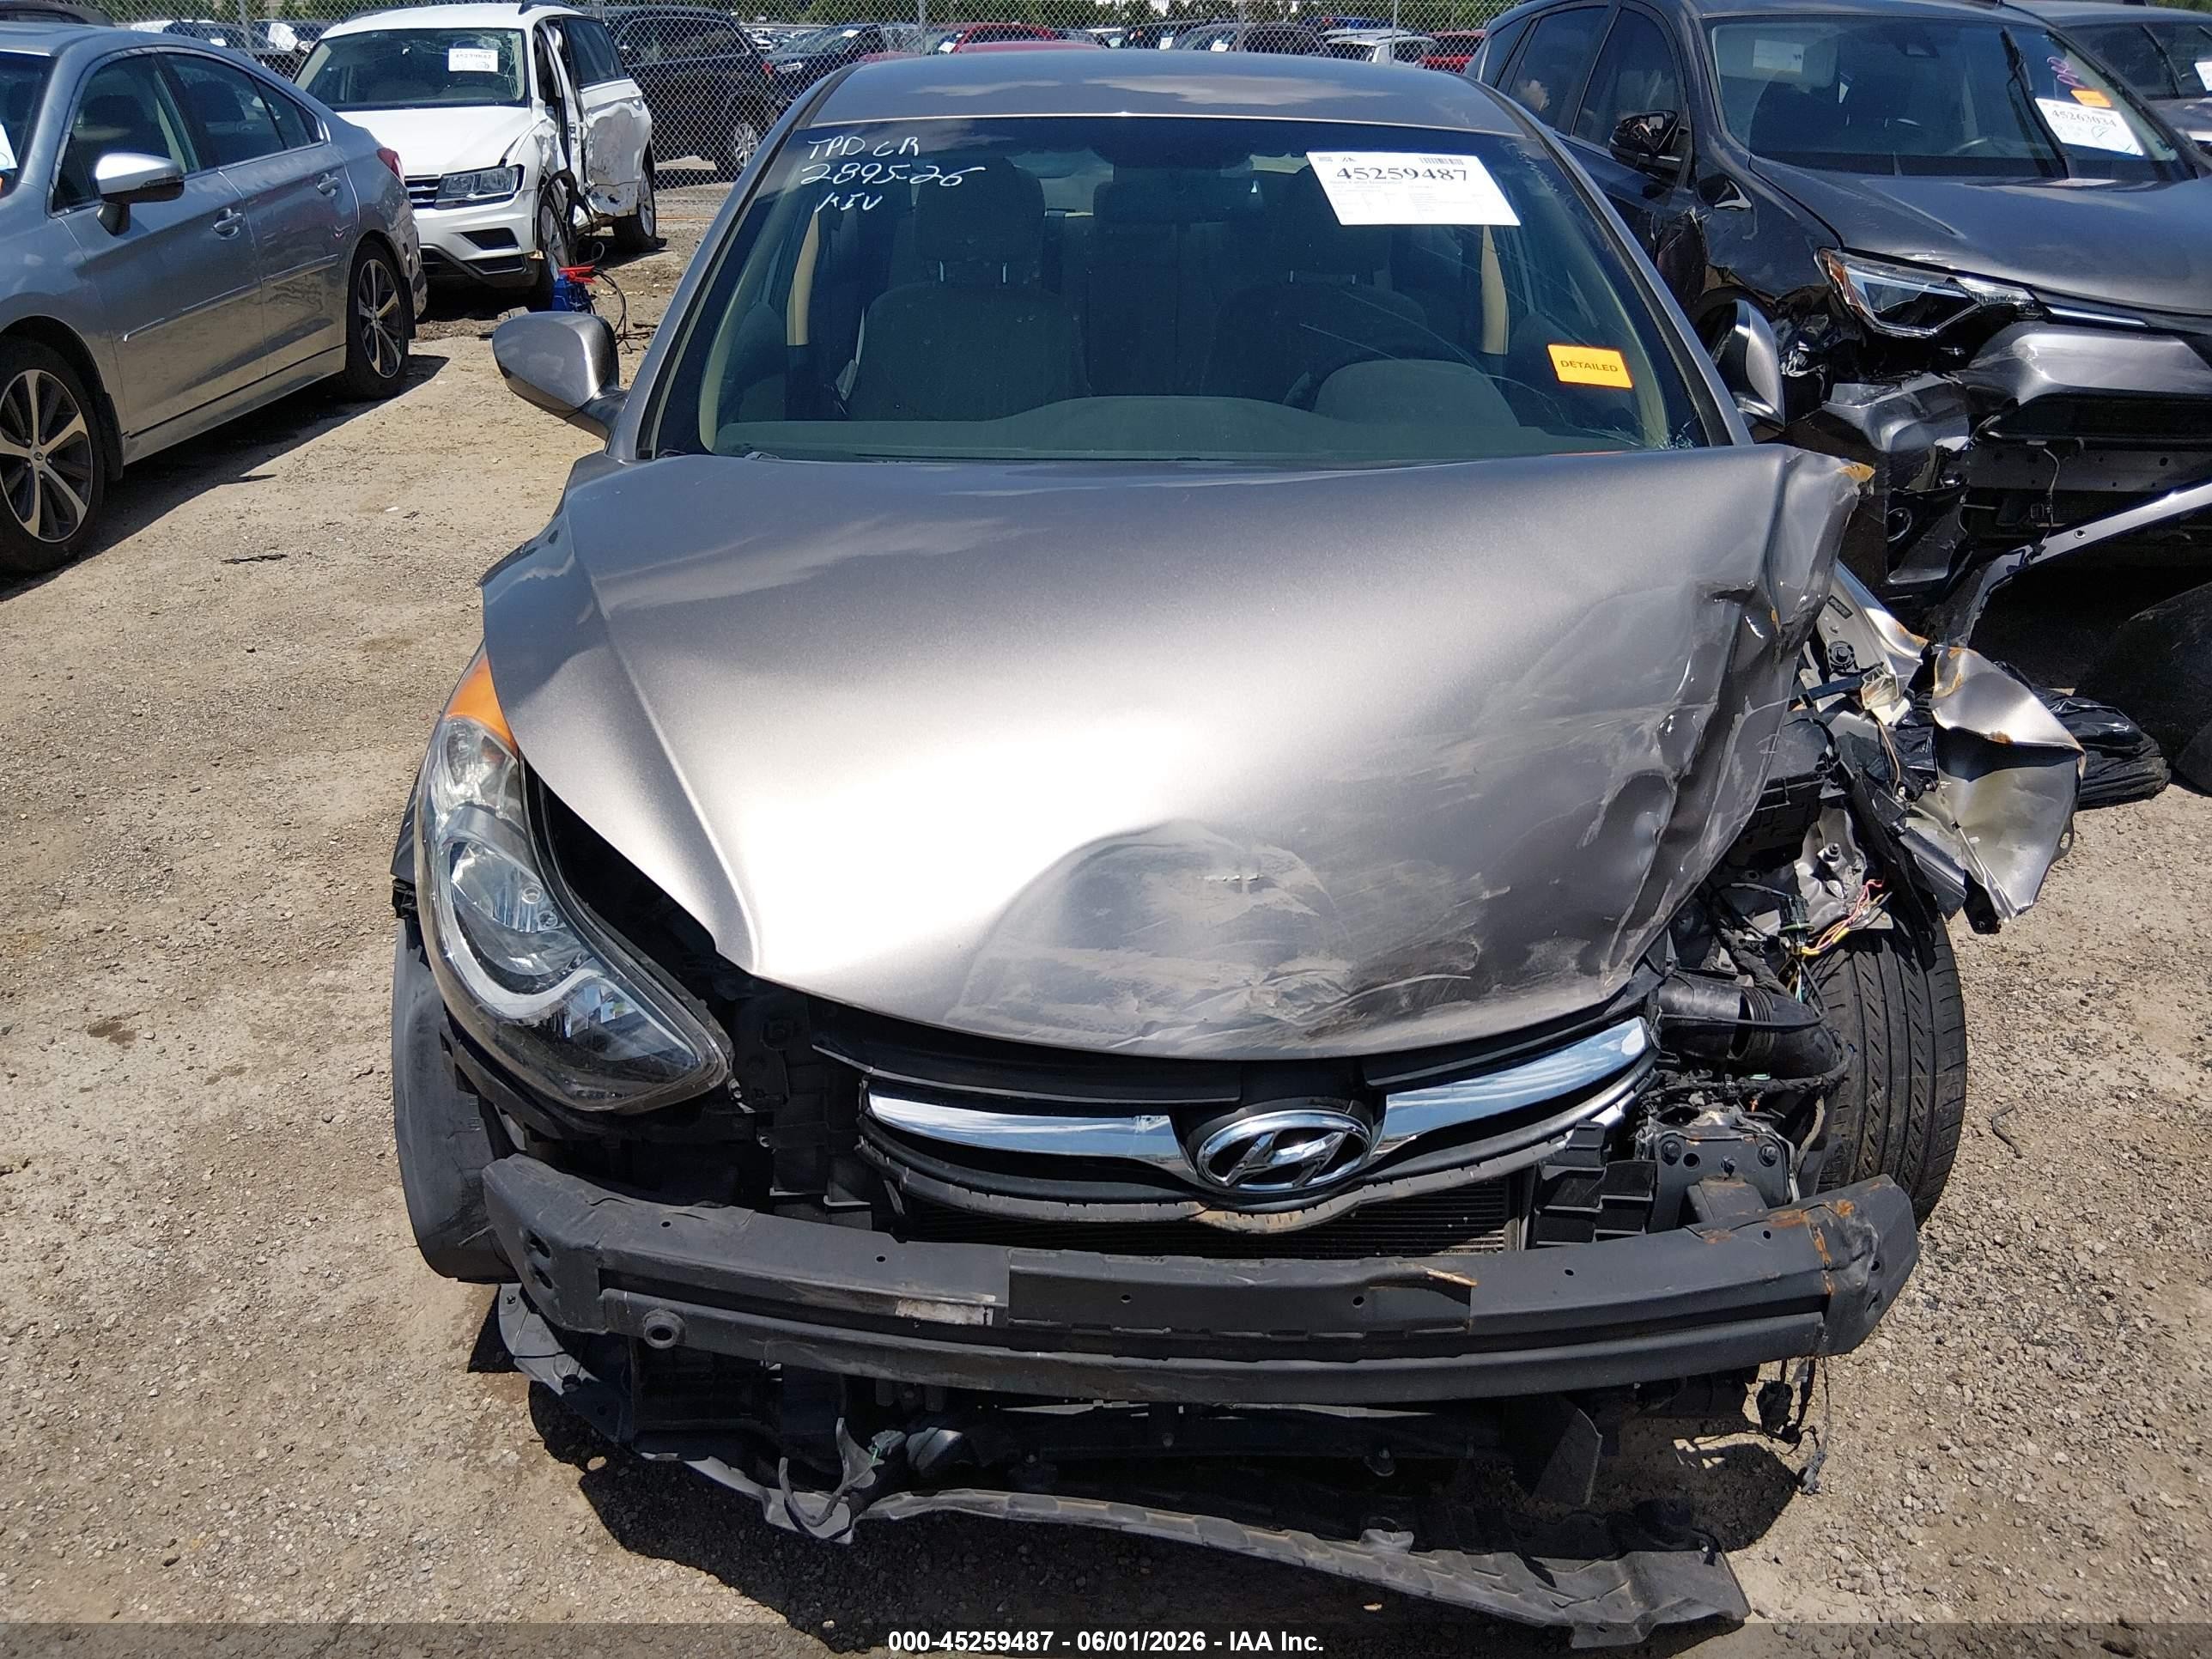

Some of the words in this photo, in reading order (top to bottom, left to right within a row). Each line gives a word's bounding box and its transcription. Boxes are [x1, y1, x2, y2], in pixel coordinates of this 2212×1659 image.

[807, 135, 866, 160] TPD
[1336, 167, 1468, 181] 45259487
[1559, 359, 1619, 373] DETAILED
